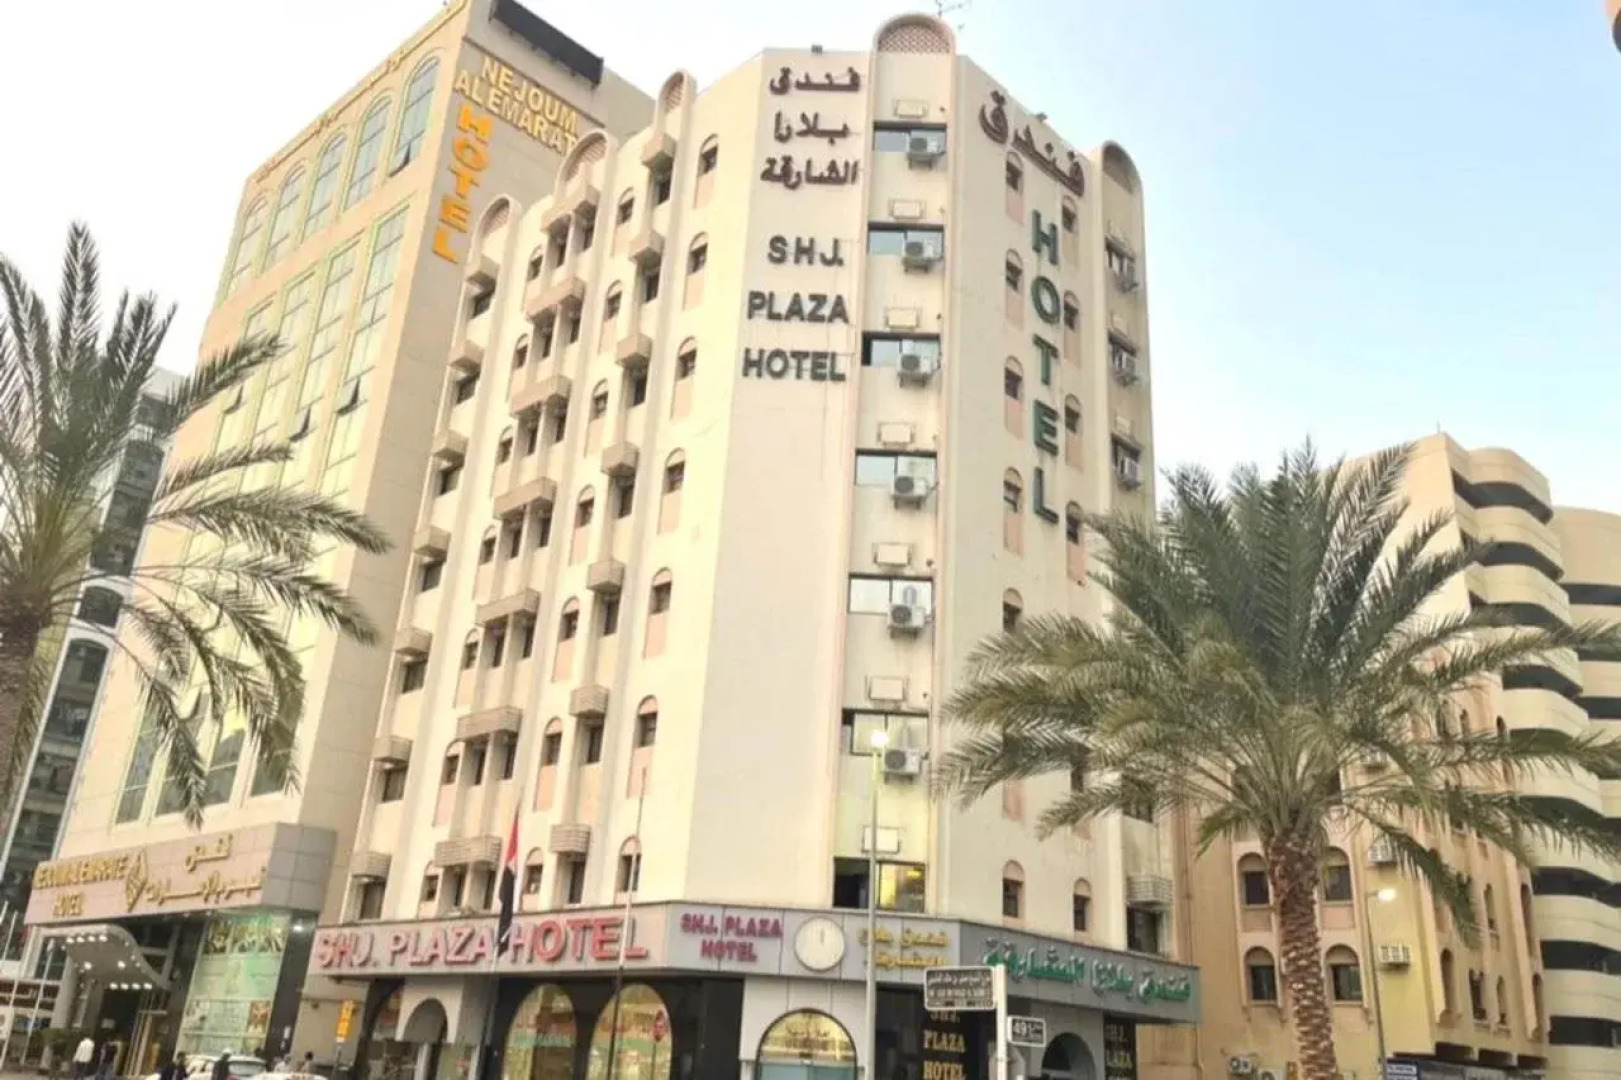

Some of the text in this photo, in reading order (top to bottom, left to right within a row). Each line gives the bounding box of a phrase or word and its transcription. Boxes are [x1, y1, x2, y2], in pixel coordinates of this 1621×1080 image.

[481, 56, 579, 135] NEJOUM
[769, 66, 860, 95] فندق
[454, 70, 488, 107] AL
[487, 91, 578, 157] EMARAT
[978, 90, 1085, 197] فندق
[432, 105, 493, 264] HOTEL
[747, 290, 849, 324] PLAZA
[742, 347, 847, 382] HOTEL
[1031, 208, 1060, 525] HOTEL
[388, 921, 496, 967] PLAZA
[507, 916, 648, 964] HOTEL
[724, 915, 783, 938] PLAZA
[700, 938, 758, 962] HOTEL
[923, 1030, 966, 1053] PLAZA
[923, 1060, 967, 1080] HOTEL
